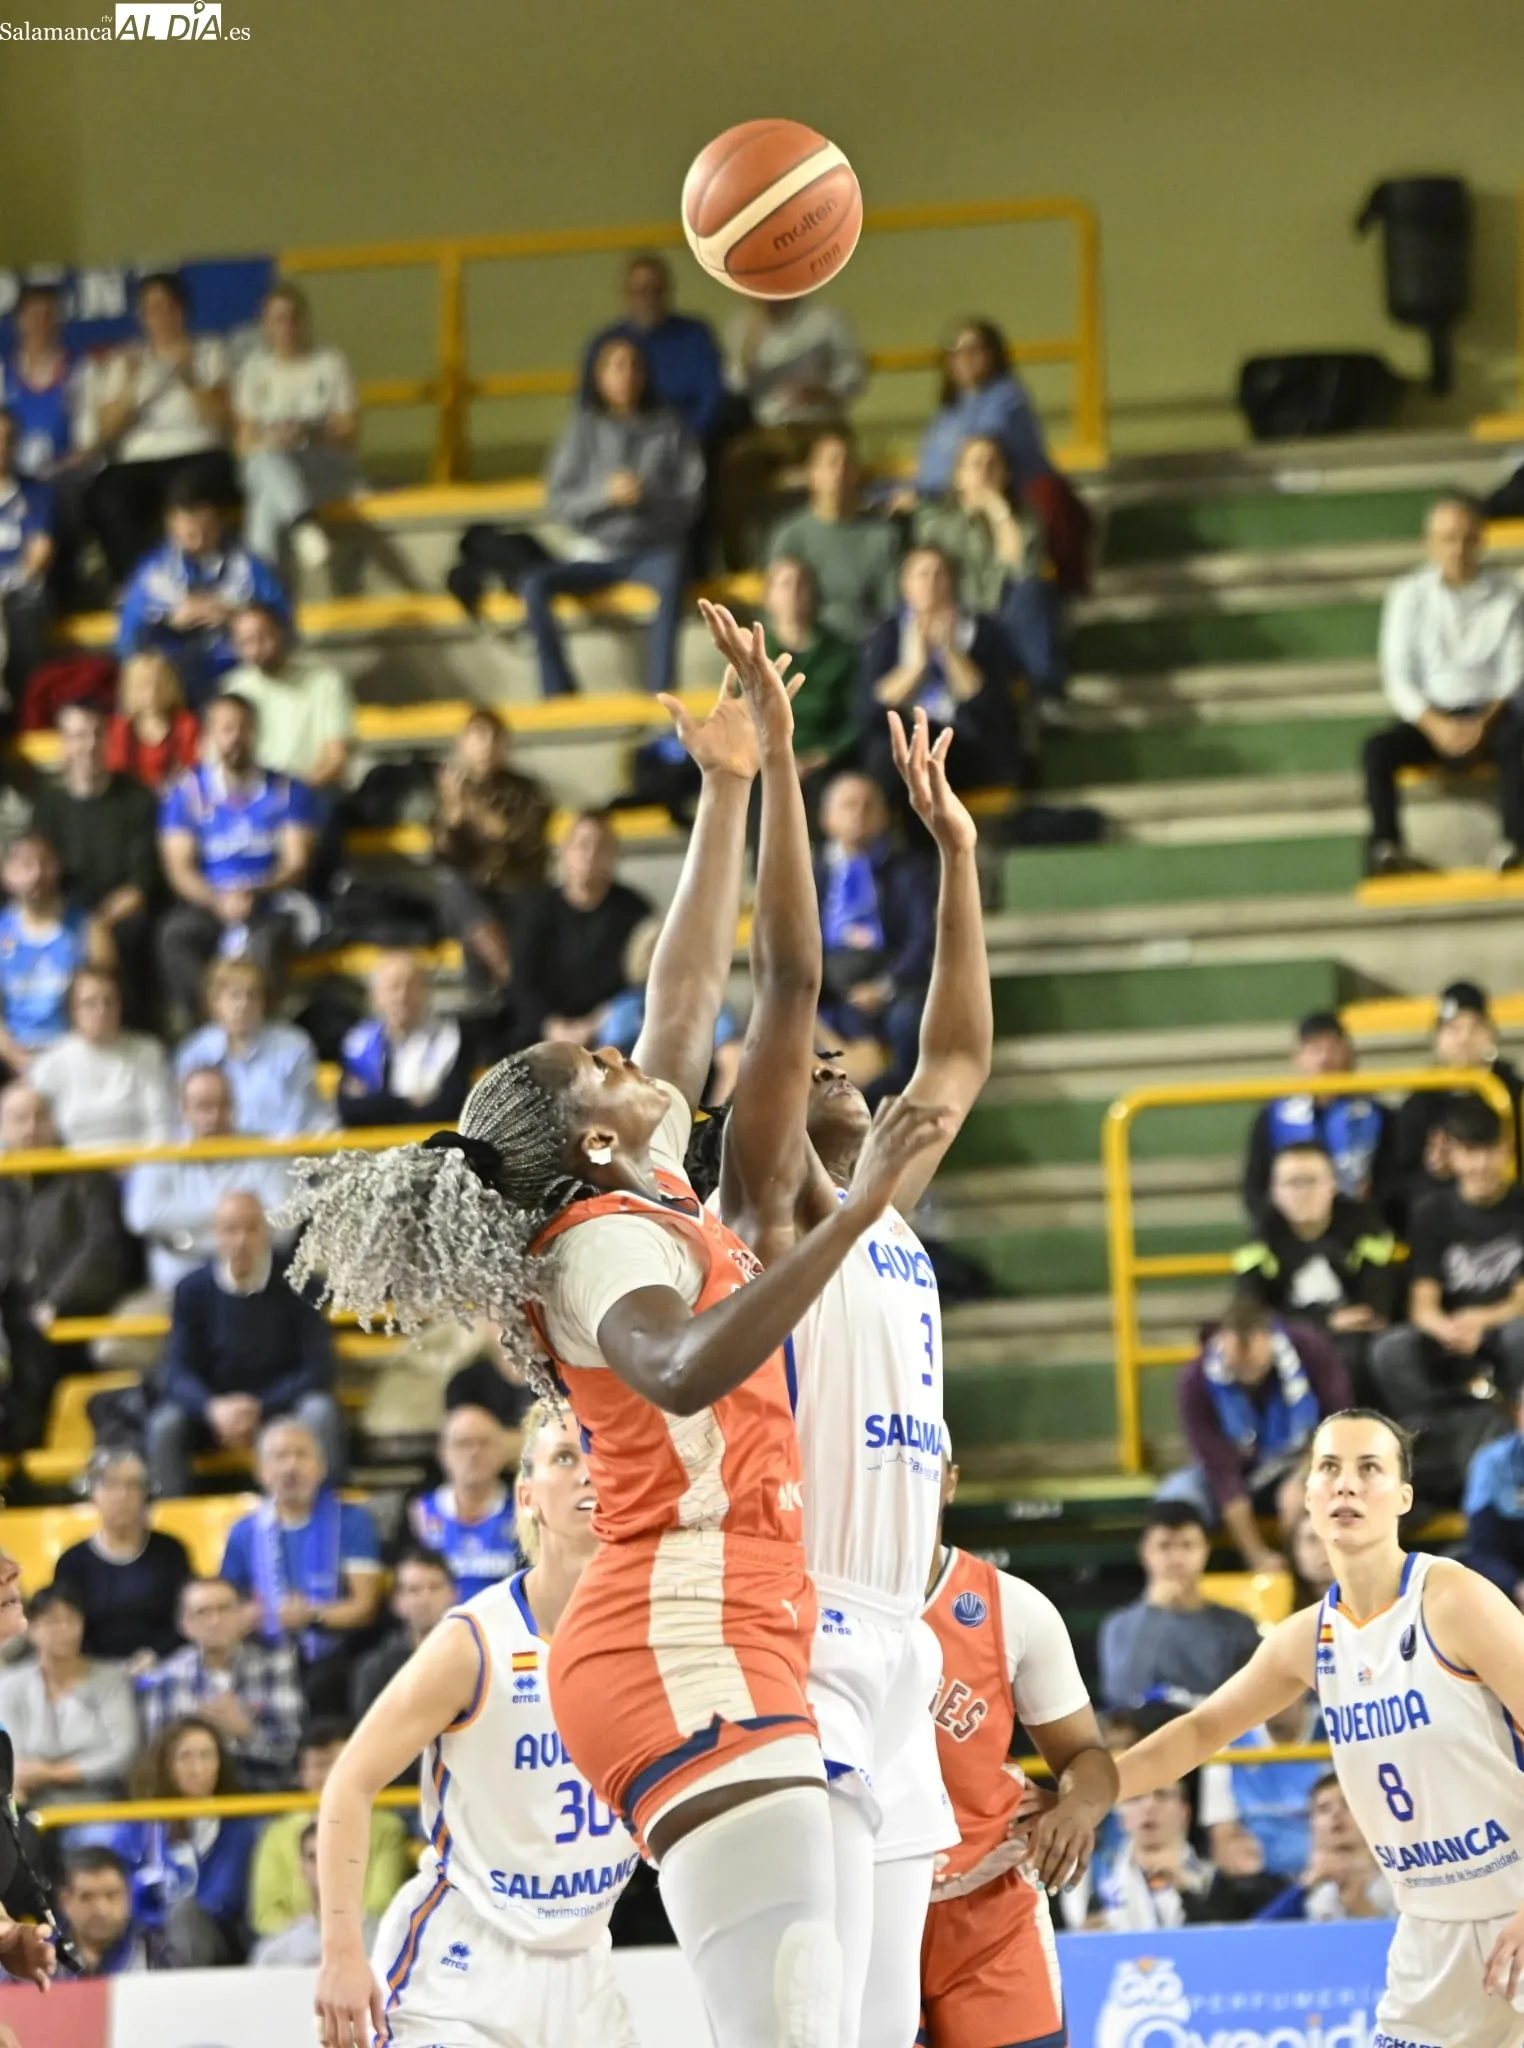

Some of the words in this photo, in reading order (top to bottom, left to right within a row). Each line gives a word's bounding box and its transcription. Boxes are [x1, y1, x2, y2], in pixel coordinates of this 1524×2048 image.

[773, 198, 838, 252] molten
[1324, 1689, 1431, 1744] AVENIDA
[555, 1780, 617, 1844] 30
[1378, 1763, 1414, 1823] 8
